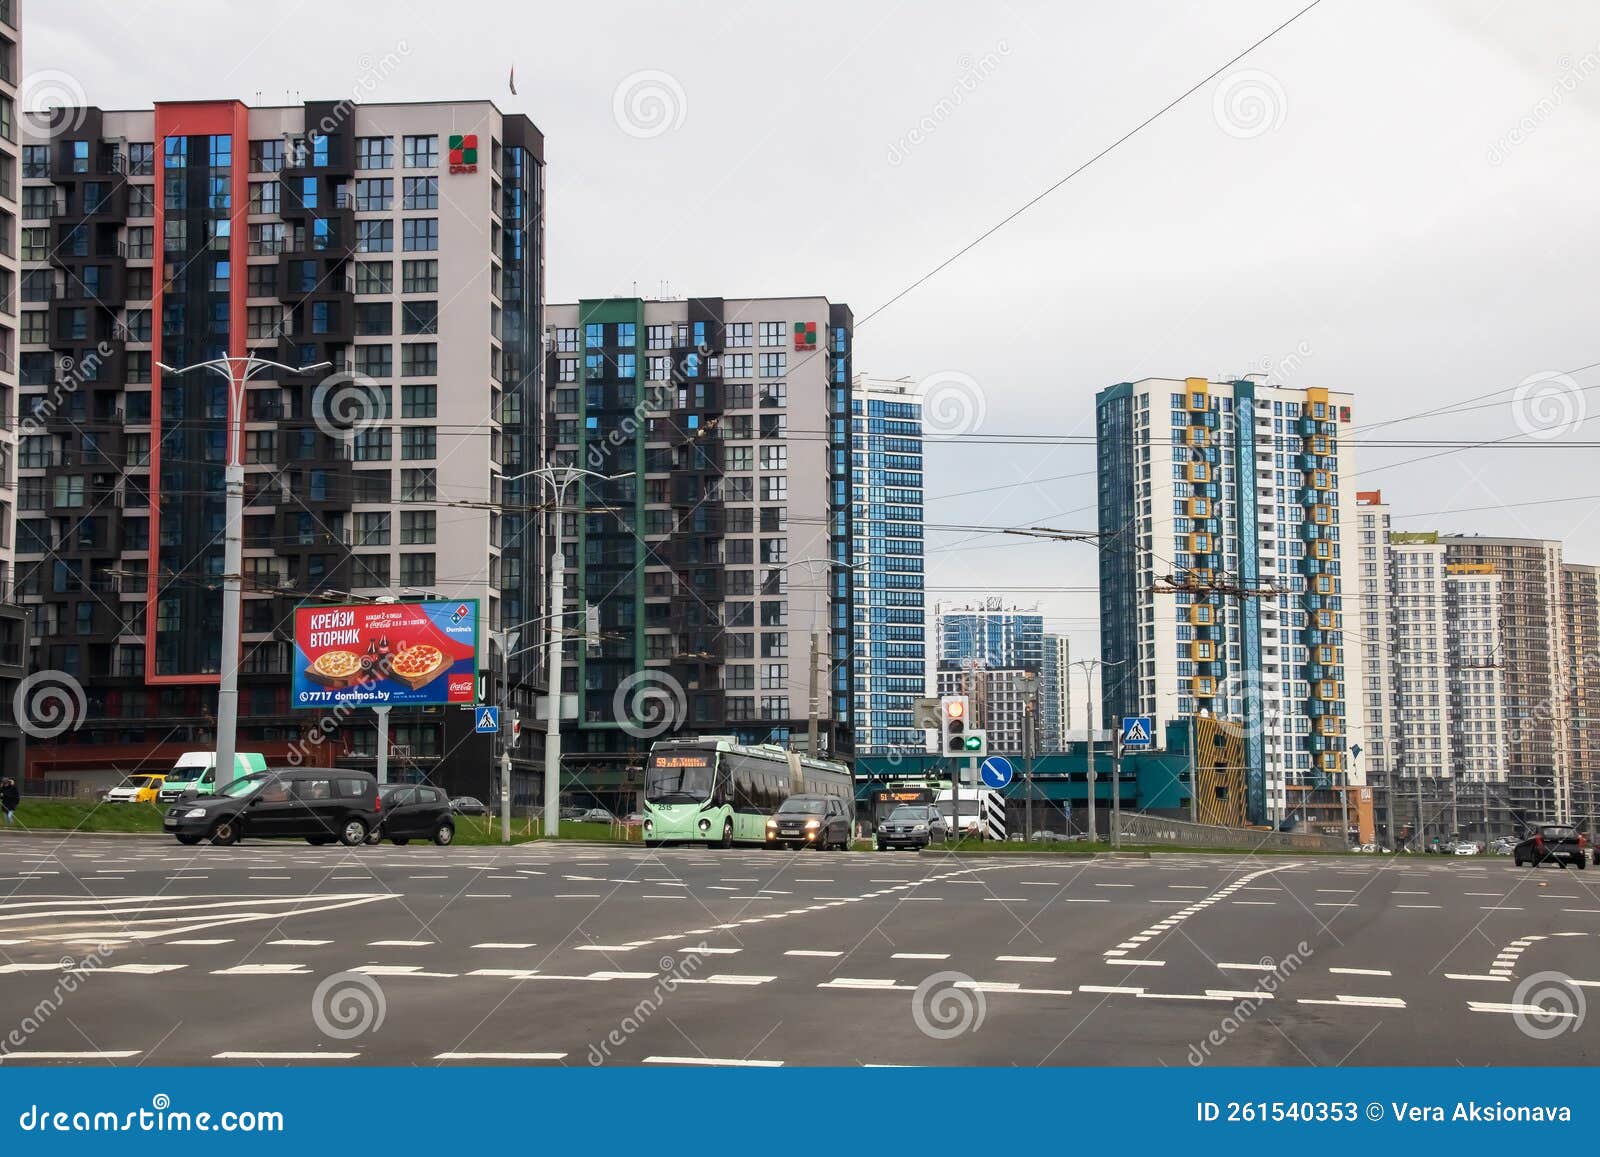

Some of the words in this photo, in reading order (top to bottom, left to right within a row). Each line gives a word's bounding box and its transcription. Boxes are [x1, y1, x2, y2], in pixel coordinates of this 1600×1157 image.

[310, 610, 355, 630] КРЕЙЗИ
[310, 628, 360, 648] ВТОРНИК
[309, 691, 332, 701] 7717
[334, 690, 390, 701] dominos.by
